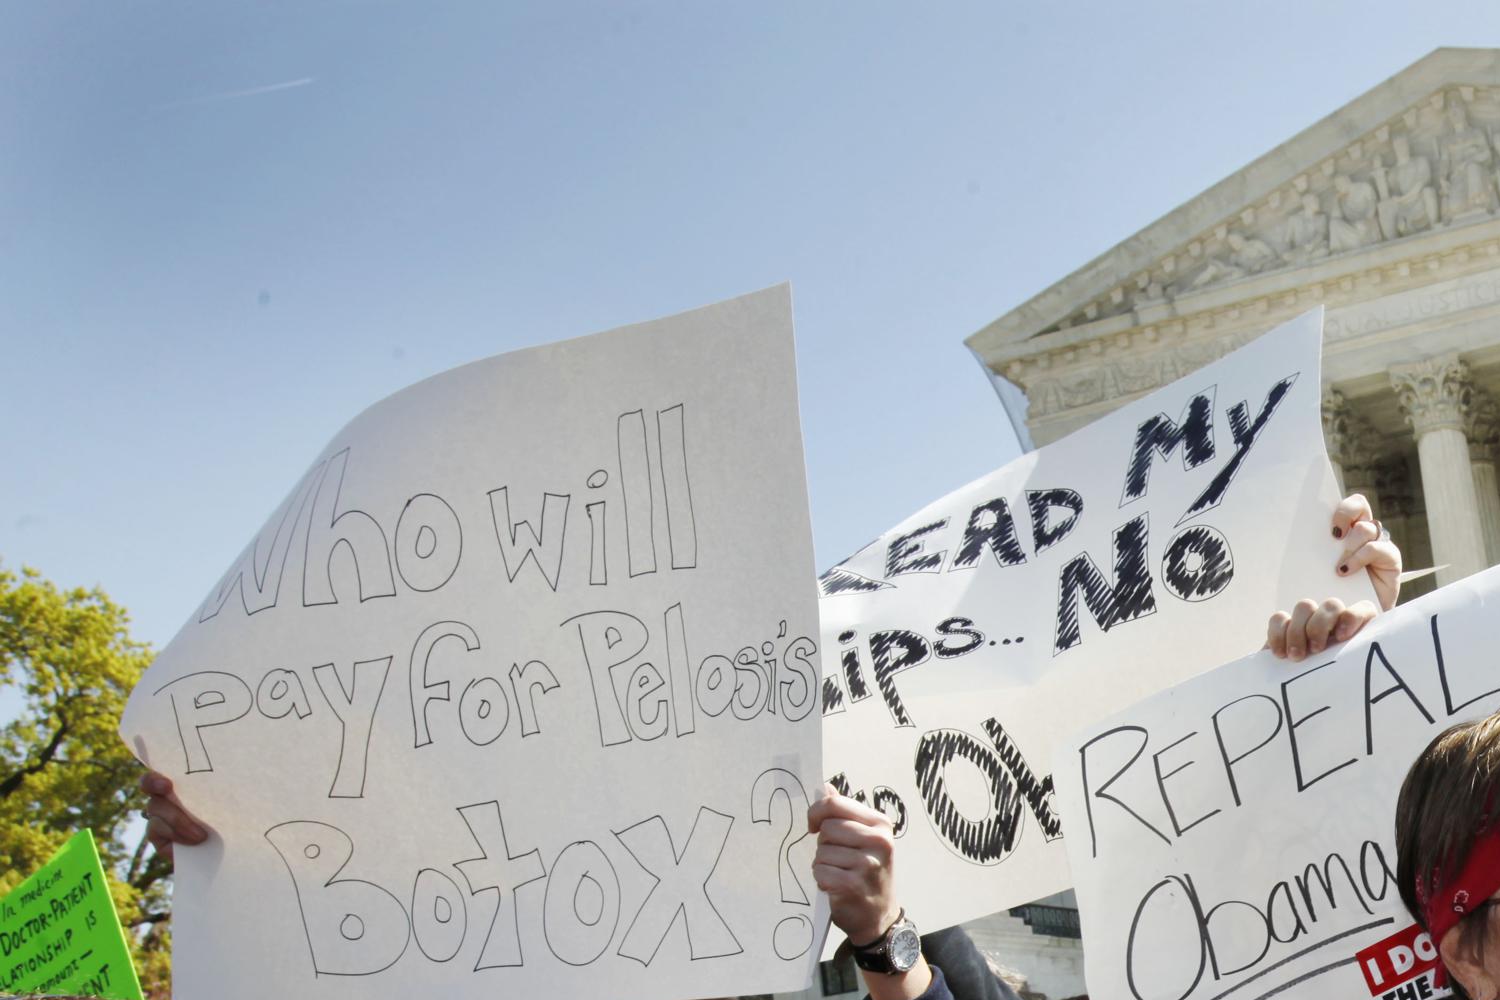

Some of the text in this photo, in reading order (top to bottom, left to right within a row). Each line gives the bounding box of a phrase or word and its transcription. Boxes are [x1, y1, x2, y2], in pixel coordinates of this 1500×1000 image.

[487, 403, 697, 592] will
[410, 620, 561, 748] for
[0, 928, 73, 992] LATIONSHIP
[1366, 957, 1384, 986] I
